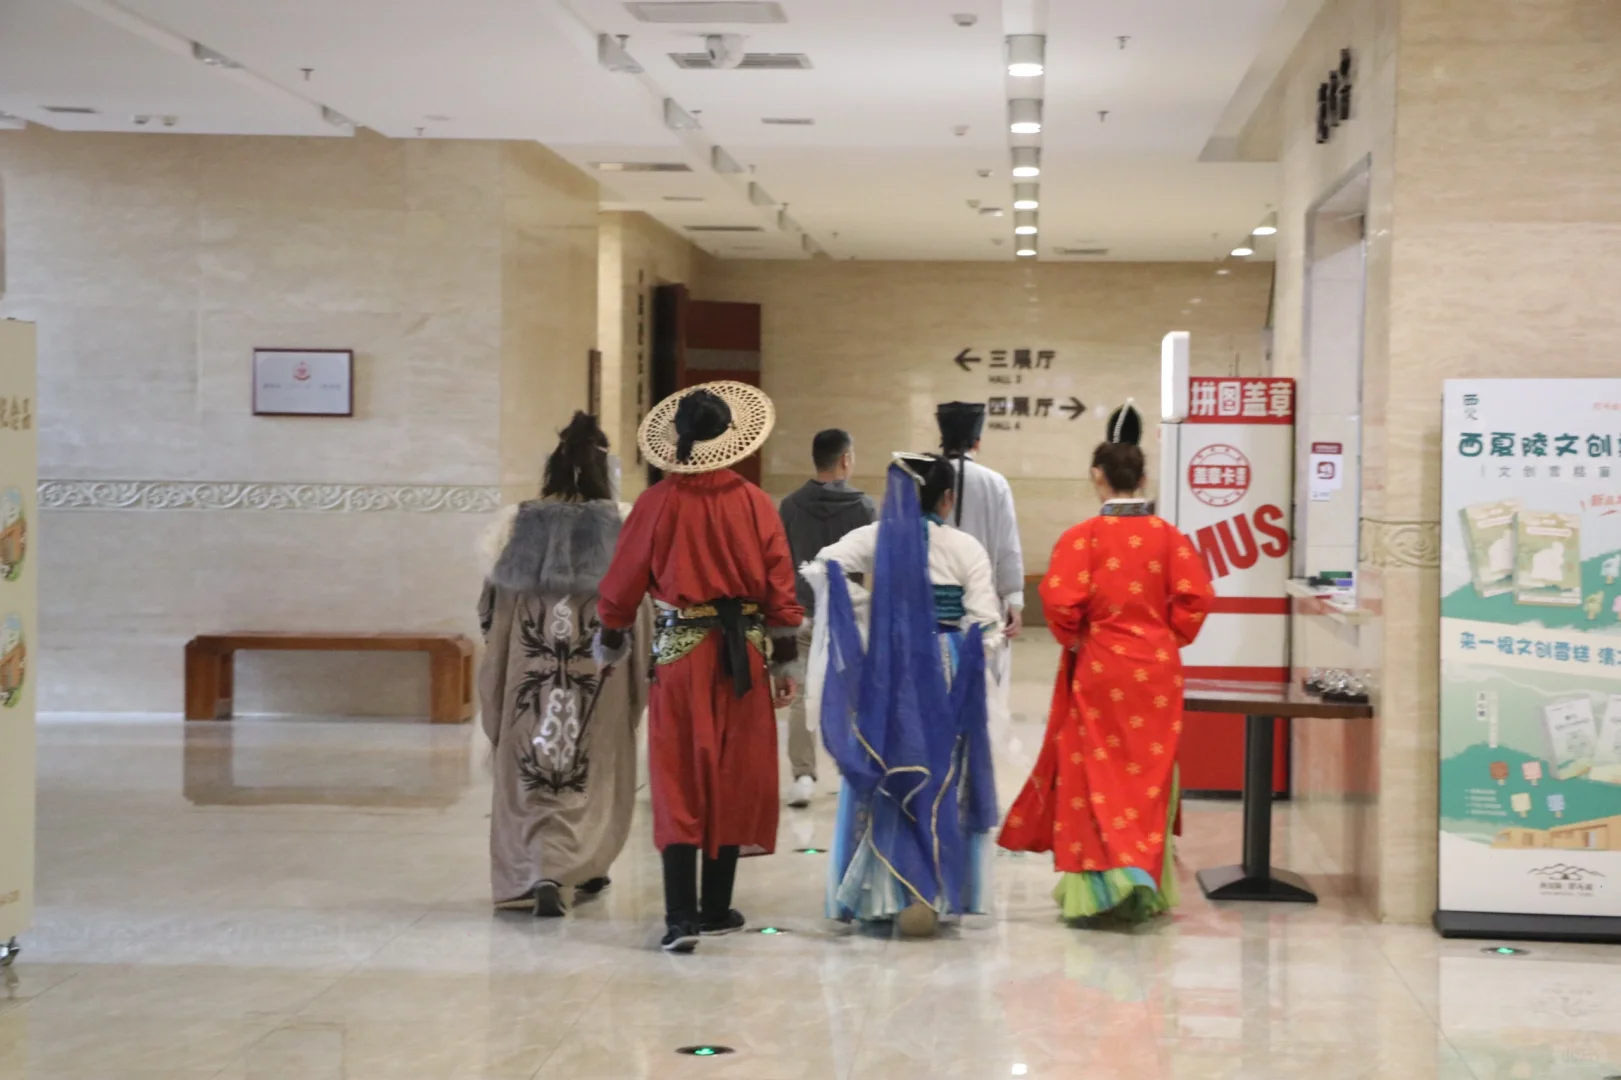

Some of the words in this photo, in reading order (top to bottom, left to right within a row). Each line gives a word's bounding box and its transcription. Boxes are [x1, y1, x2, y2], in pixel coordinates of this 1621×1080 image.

[988, 349, 1056, 369] 三展厅
[988, 374, 1012, 384] HALL
[988, 396, 1054, 416] 四展厅
[1190, 381, 1292, 418] 拼图盖章
[1457, 432, 1621, 457] 西夏陵文创
